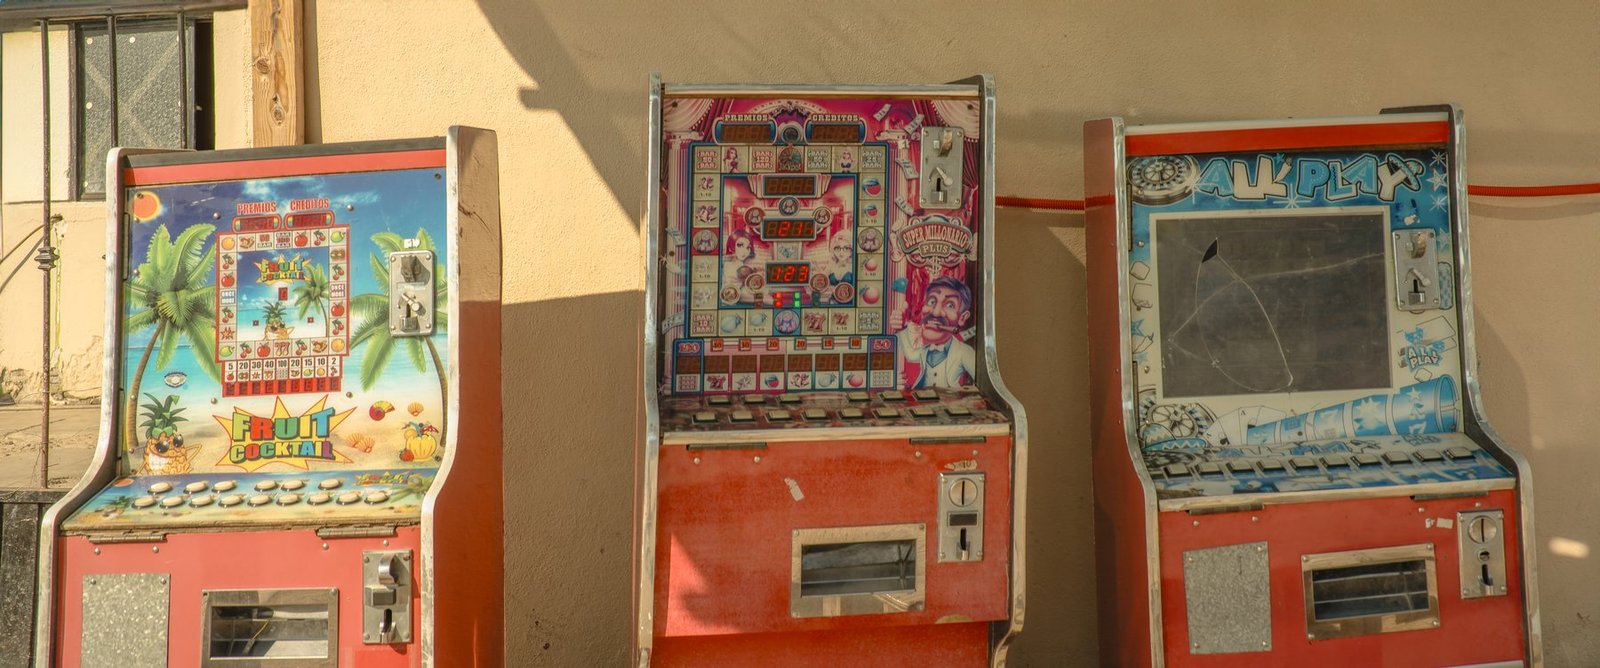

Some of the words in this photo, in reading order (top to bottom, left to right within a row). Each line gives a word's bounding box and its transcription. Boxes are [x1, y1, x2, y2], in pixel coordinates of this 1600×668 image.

[1200, 155, 1289, 200] ALL
[1297, 154, 1408, 201] PLAY
[237, 201, 277, 215] PREMIOS
[290, 198, 330, 211] CREDITOS
[902, 226, 924, 249] SUPER
[925, 223, 968, 247] MILLONARIO
[922, 244, 948, 253] PLUS
[261, 258, 304, 273] FRUIT
[261, 271, 305, 282] COCKTAIL
[775, 265, 809, 282] 123
[1408, 347, 1439, 359] ALL
[228, 362, 233, 370] 5
[239, 362, 248, 370] 20
[252, 361, 261, 369] 30
[264, 360, 274, 369] 40
[278, 360, 287, 368] 100
[290, 358, 300, 366] 20
[304, 358, 313, 366] 15
[331, 357, 337, 365] 2
[1409, 356, 1439, 369] PLAY
[232, 406, 336, 442] FRUIT
[229, 440, 336, 464] COCKTAIL
